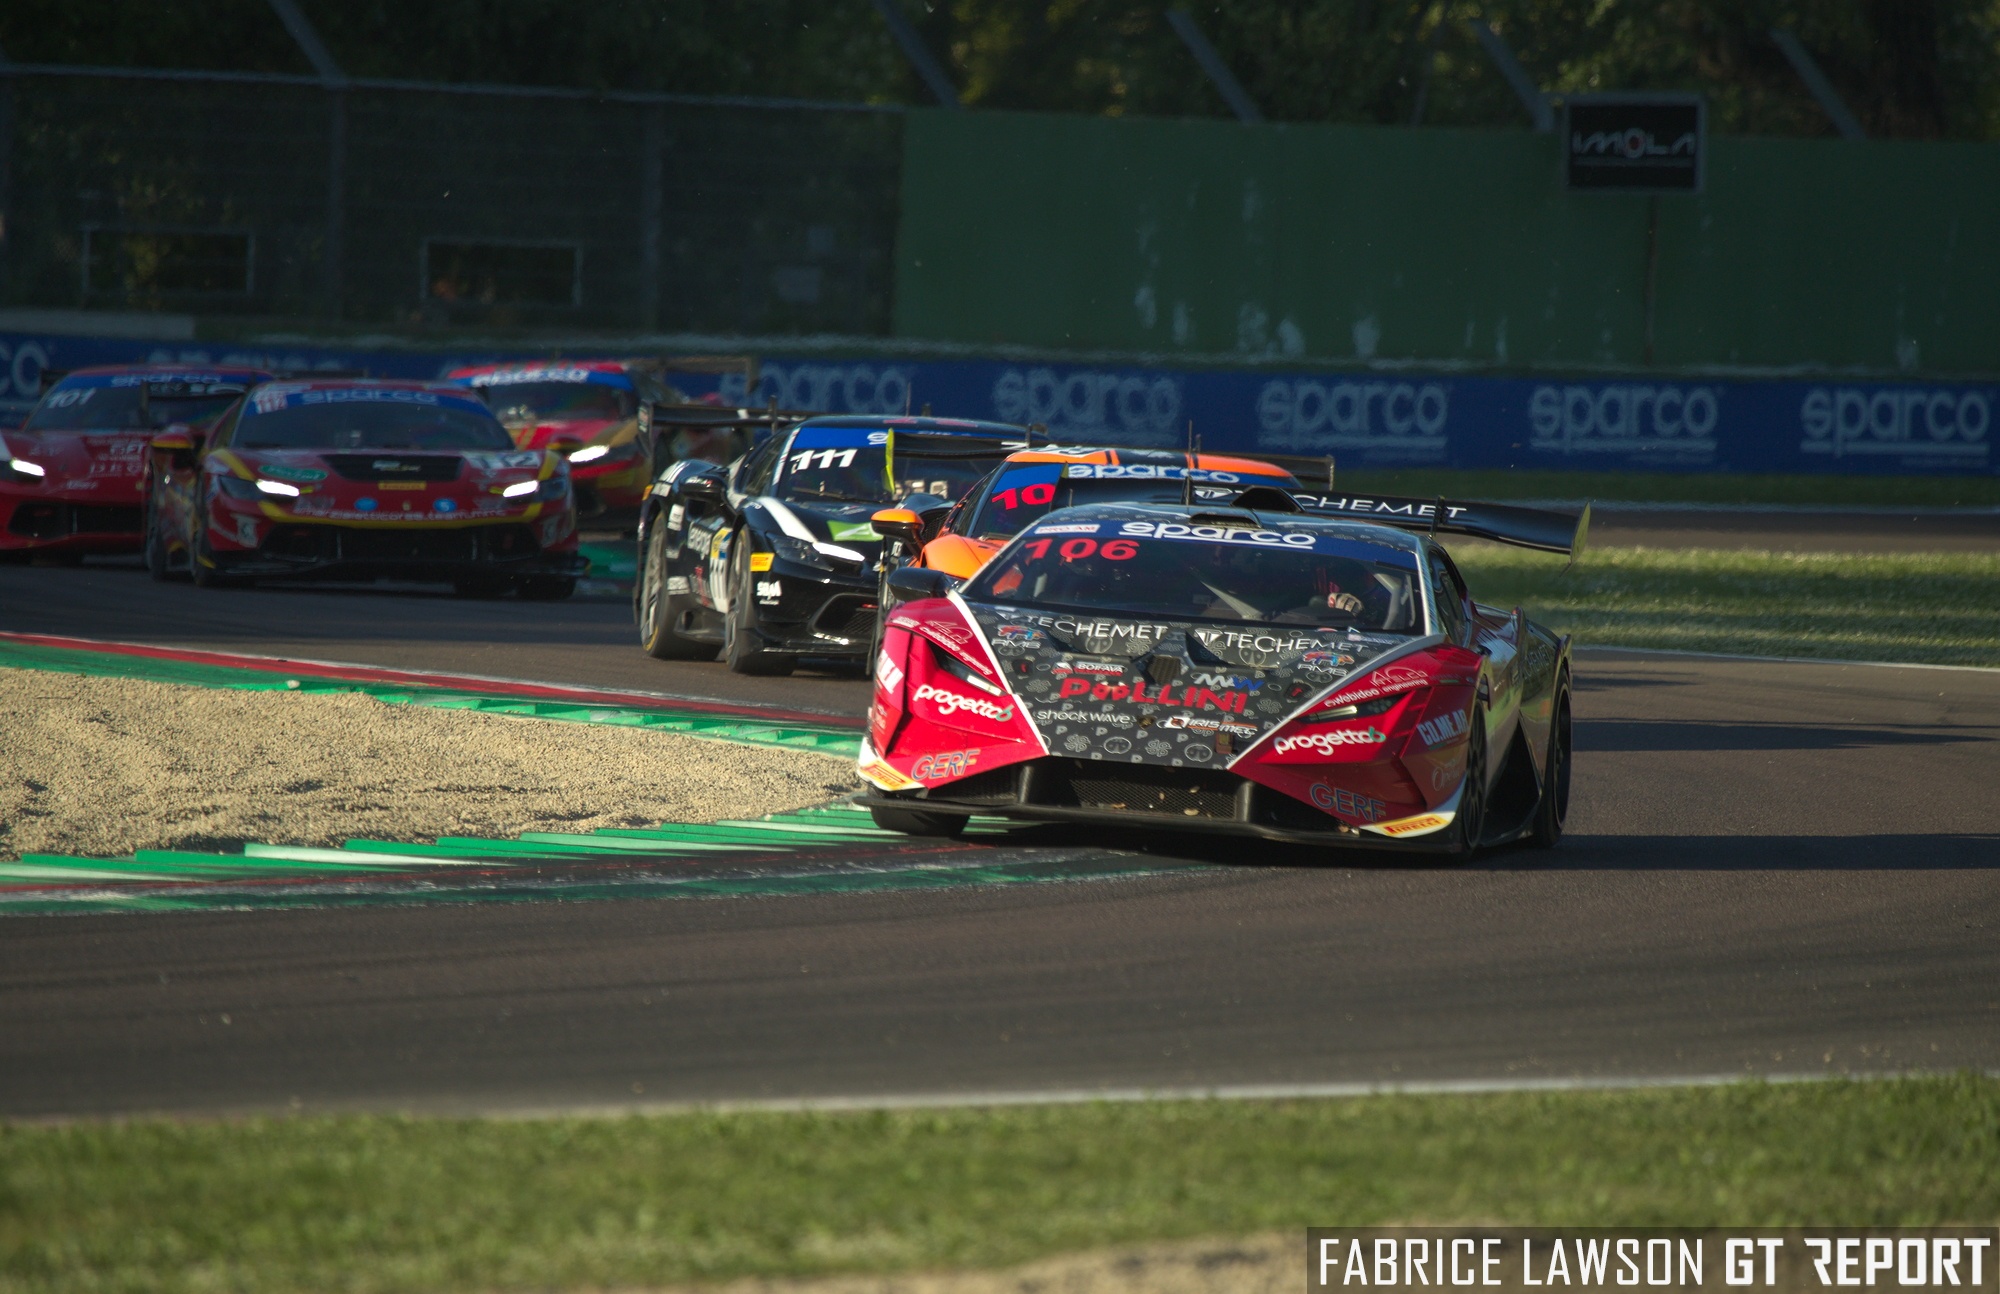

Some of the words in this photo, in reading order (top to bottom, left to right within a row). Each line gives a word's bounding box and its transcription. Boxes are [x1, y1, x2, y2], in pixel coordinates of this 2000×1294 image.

[48, 387, 96, 409] 101
[1257, 380, 1448, 449] sparco
[1531, 385, 1719, 453] sparco
[1801, 389, 1990, 457] sparco
[790, 448, 858, 471] 111
[1067, 464, 1241, 484] sparco
[1119, 521, 1316, 549] sparco
[1024, 538, 1140, 560] 106
[1022, 615, 1168, 640] TECHEMET
[1223, 631, 1369, 653] TECHEMET
